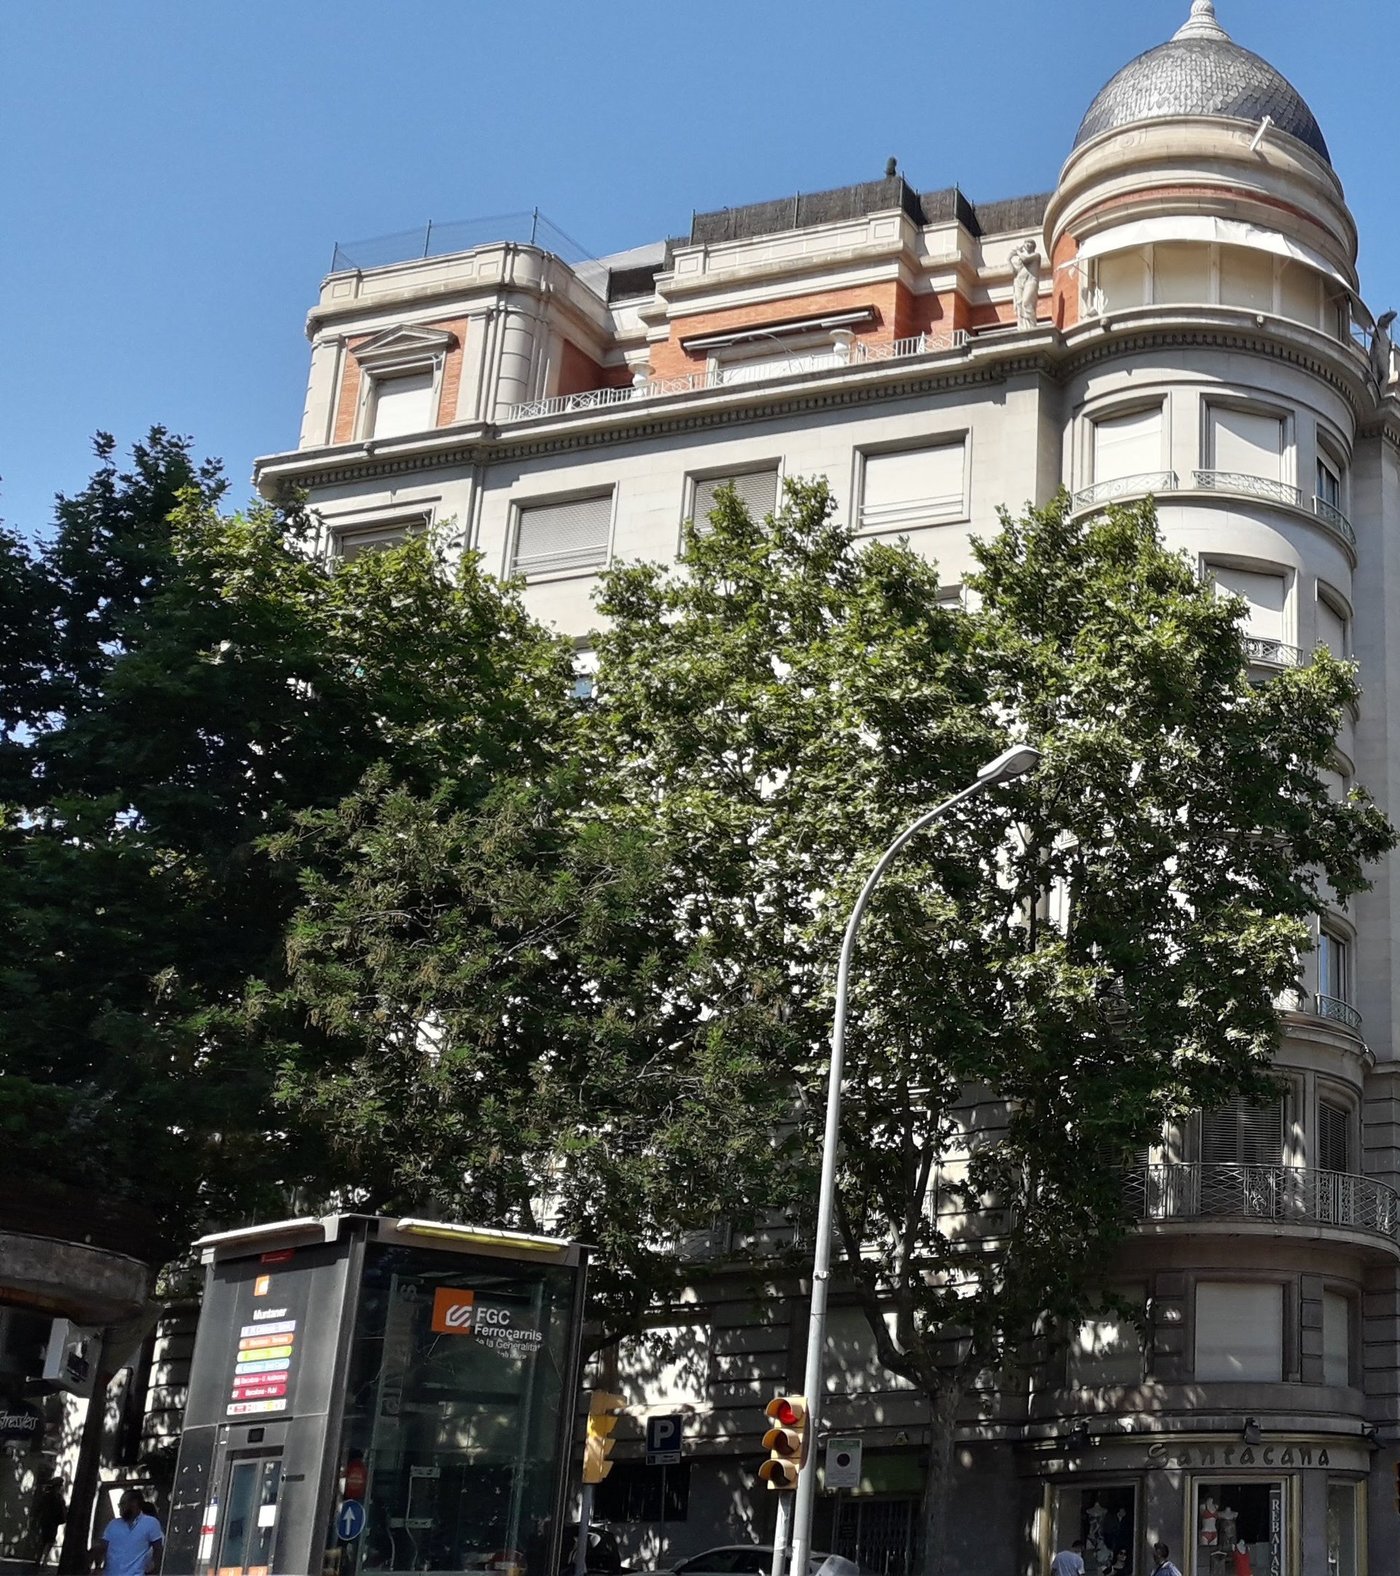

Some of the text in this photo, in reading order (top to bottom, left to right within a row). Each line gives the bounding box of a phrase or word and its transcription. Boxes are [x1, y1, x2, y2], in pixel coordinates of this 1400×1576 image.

[253, 1308, 287, 1320] Muntaner
[476, 1307, 511, 1325] FGC
[474, 1323, 542, 1342] Ferrocarrils
[654, 1420, 675, 1448] P
[1271, 1499, 1280, 1576] REBAJAS
